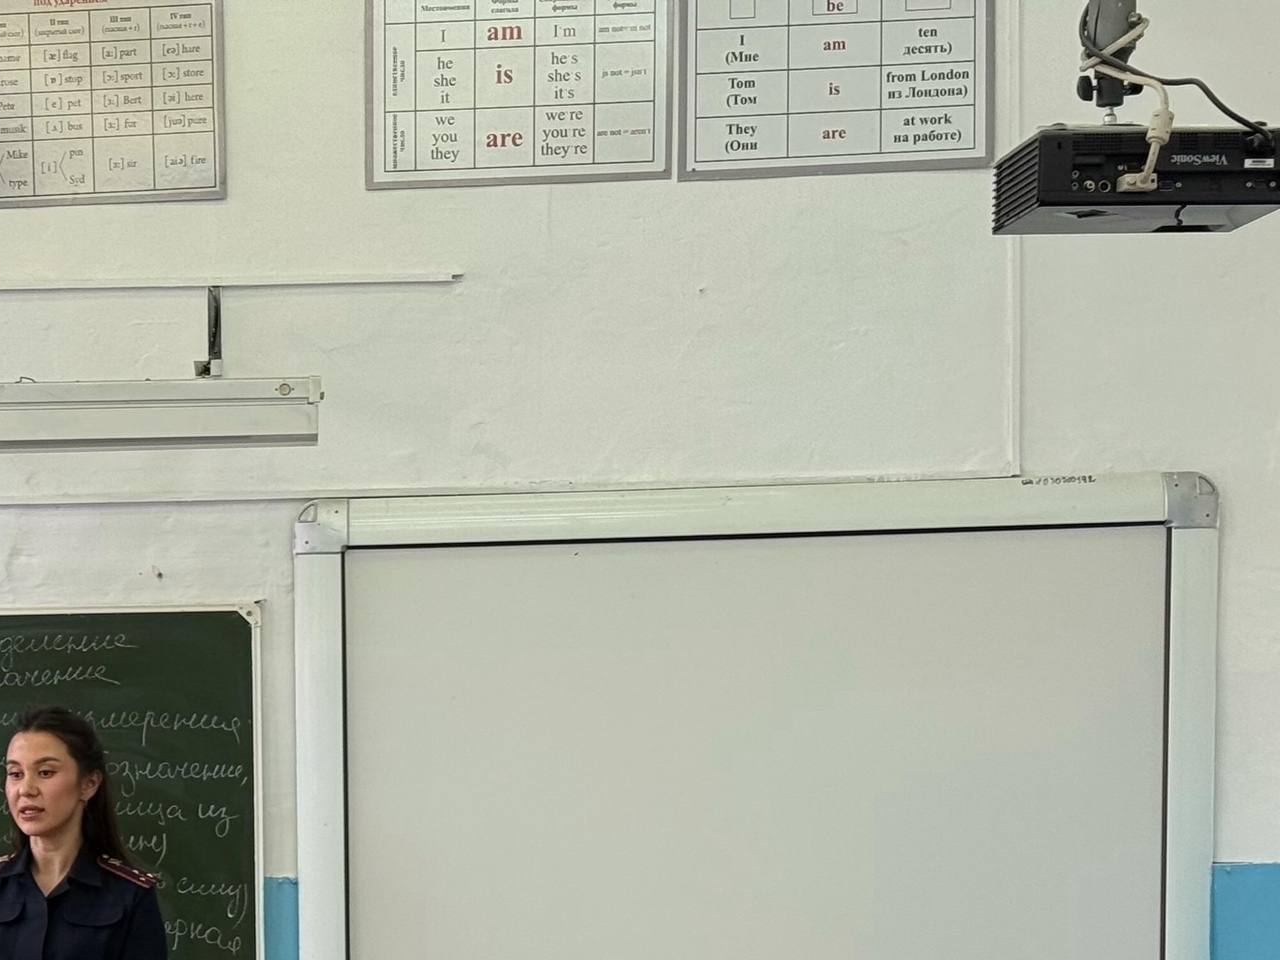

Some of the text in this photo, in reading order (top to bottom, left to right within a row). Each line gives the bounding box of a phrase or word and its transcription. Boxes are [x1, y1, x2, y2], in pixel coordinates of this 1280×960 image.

[826, 0, 844, 12] be
[440, 29, 446, 43] I
[487, 25, 523, 41] am
[554, 24, 576, 38] I'm
[918, 26, 938, 38] ten
[740, 35, 745, 46] I
[823, 40, 846, 51] am
[903, 43, 952, 56] десять)
[437, 57, 453, 70] he
[551, 52, 578, 65] he's
[725, 51, 759, 64] (Мне
[433, 74, 457, 87] she
[495, 64, 513, 84] is
[547, 69, 581, 83] she's
[886, 69, 970, 83] from London
[728, 78, 756, 90] Tom
[828, 83, 840, 96] is
[440, 91, 450, 104] it
[554, 86, 575, 99] it's
[888, 85, 968, 100] из Лондона)
[726, 94, 757, 107] (Том
[435, 116, 455, 126] we
[545, 110, 583, 122] we're
[903, 113, 952, 126] at work
[542, 127, 586, 140] you're
[726, 124, 757, 137] They
[822, 129, 846, 141] are
[432, 133, 458, 146] you
[486, 132, 523, 148] are
[893, 130, 962, 145] на работе)
[541, 143, 588, 158] they're
[725, 140, 758, 153] (Они
[431, 148, 459, 163] they
[1171, 154, 1228, 166] ViewSonic
